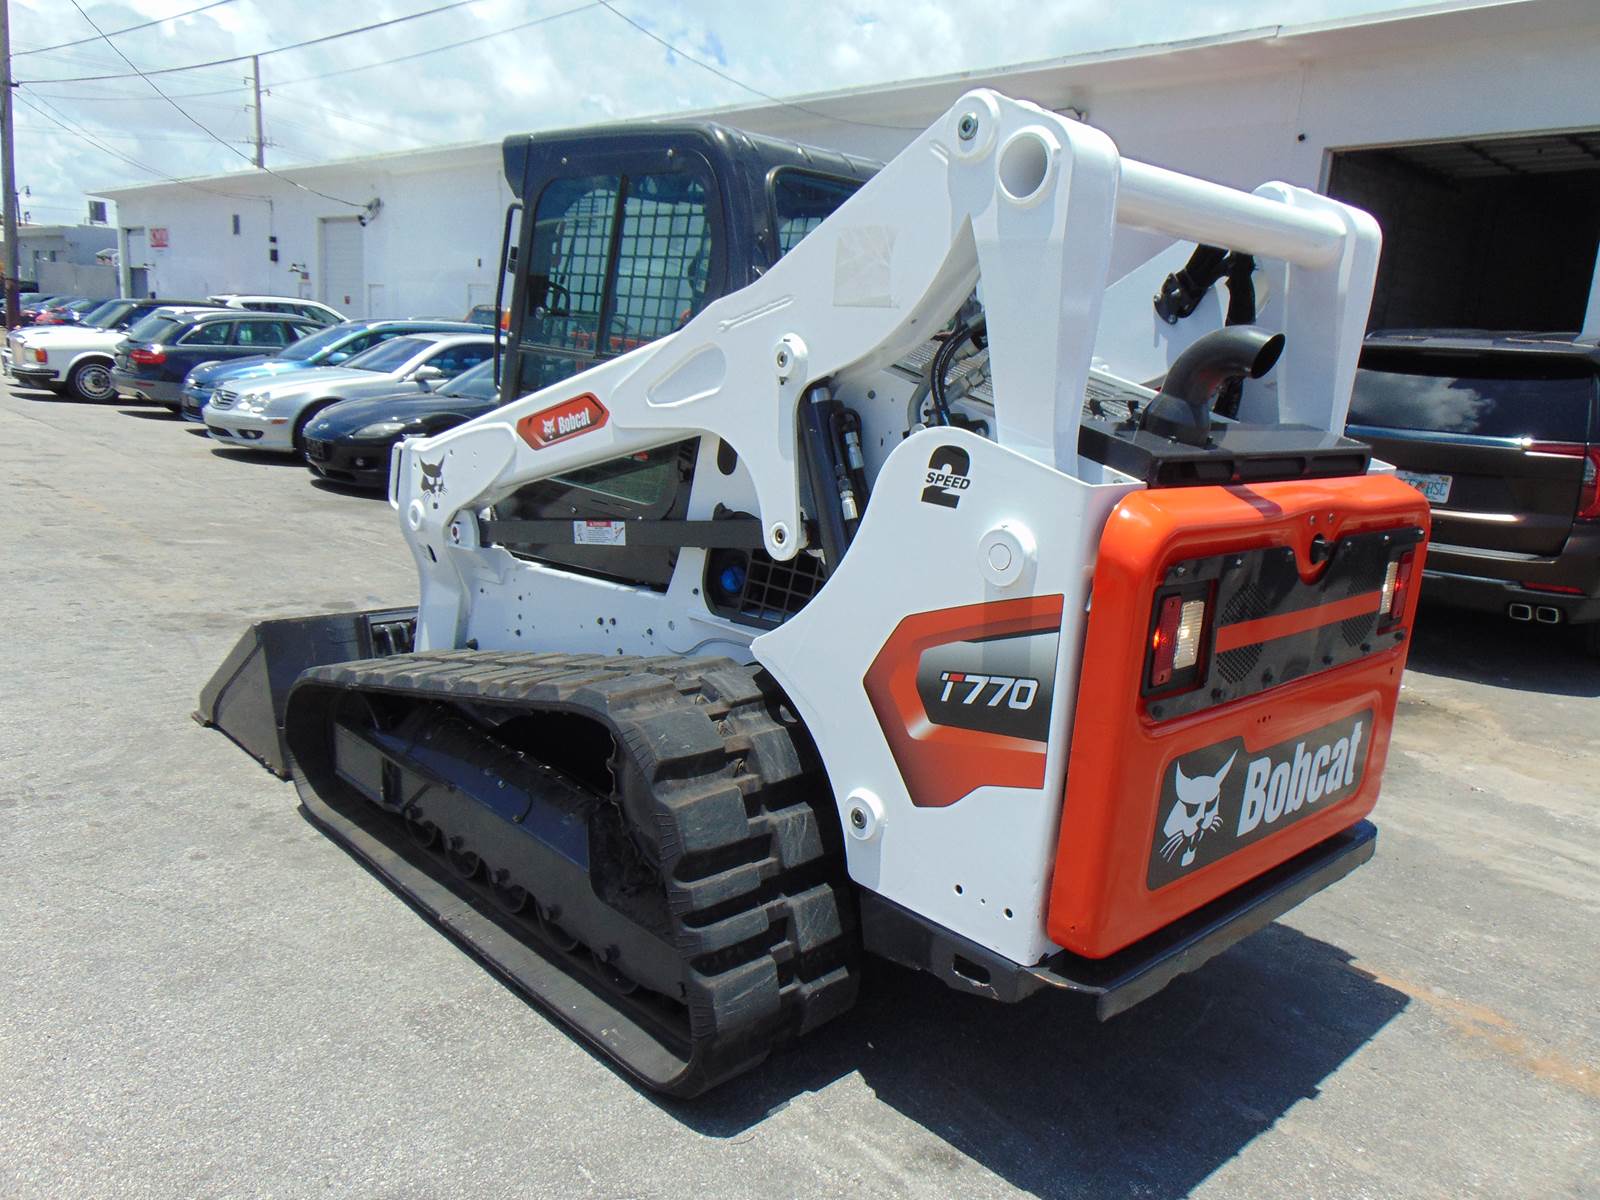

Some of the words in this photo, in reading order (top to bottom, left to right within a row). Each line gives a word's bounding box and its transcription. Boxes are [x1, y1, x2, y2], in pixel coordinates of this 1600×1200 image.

[558, 407, 591, 434] Bobcat
[921, 445, 970, 508] 2
[926, 472, 971, 489] SPEED
[940, 671, 1039, 710] T770
[1236, 721, 1362, 837] Bobcat
